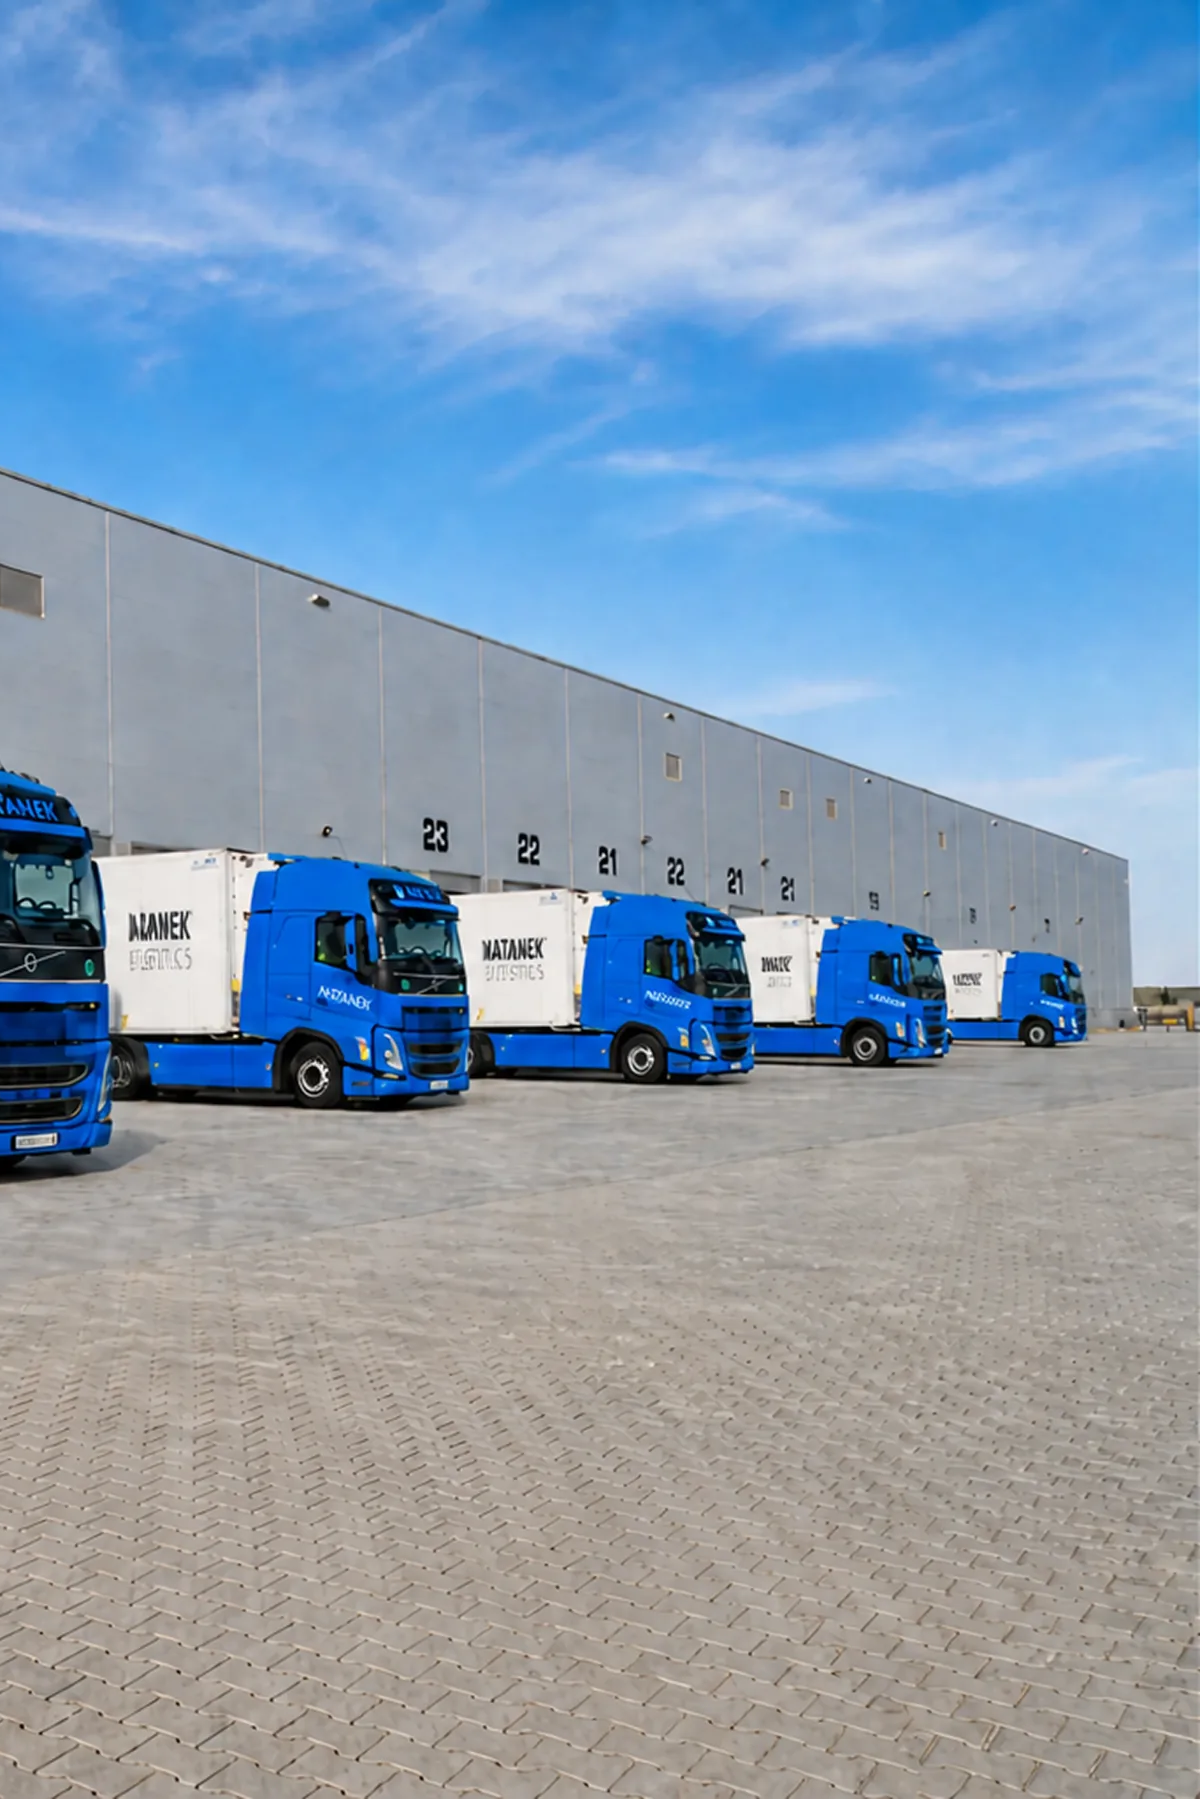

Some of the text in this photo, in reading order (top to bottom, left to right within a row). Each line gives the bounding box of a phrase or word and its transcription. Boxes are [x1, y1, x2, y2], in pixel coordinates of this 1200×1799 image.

[422, 817, 449, 853] 23
[517, 832, 541, 866] 22
[598, 845, 617, 876] 21
[667, 856, 685, 887] 22
[726, 866, 744, 896] 21
